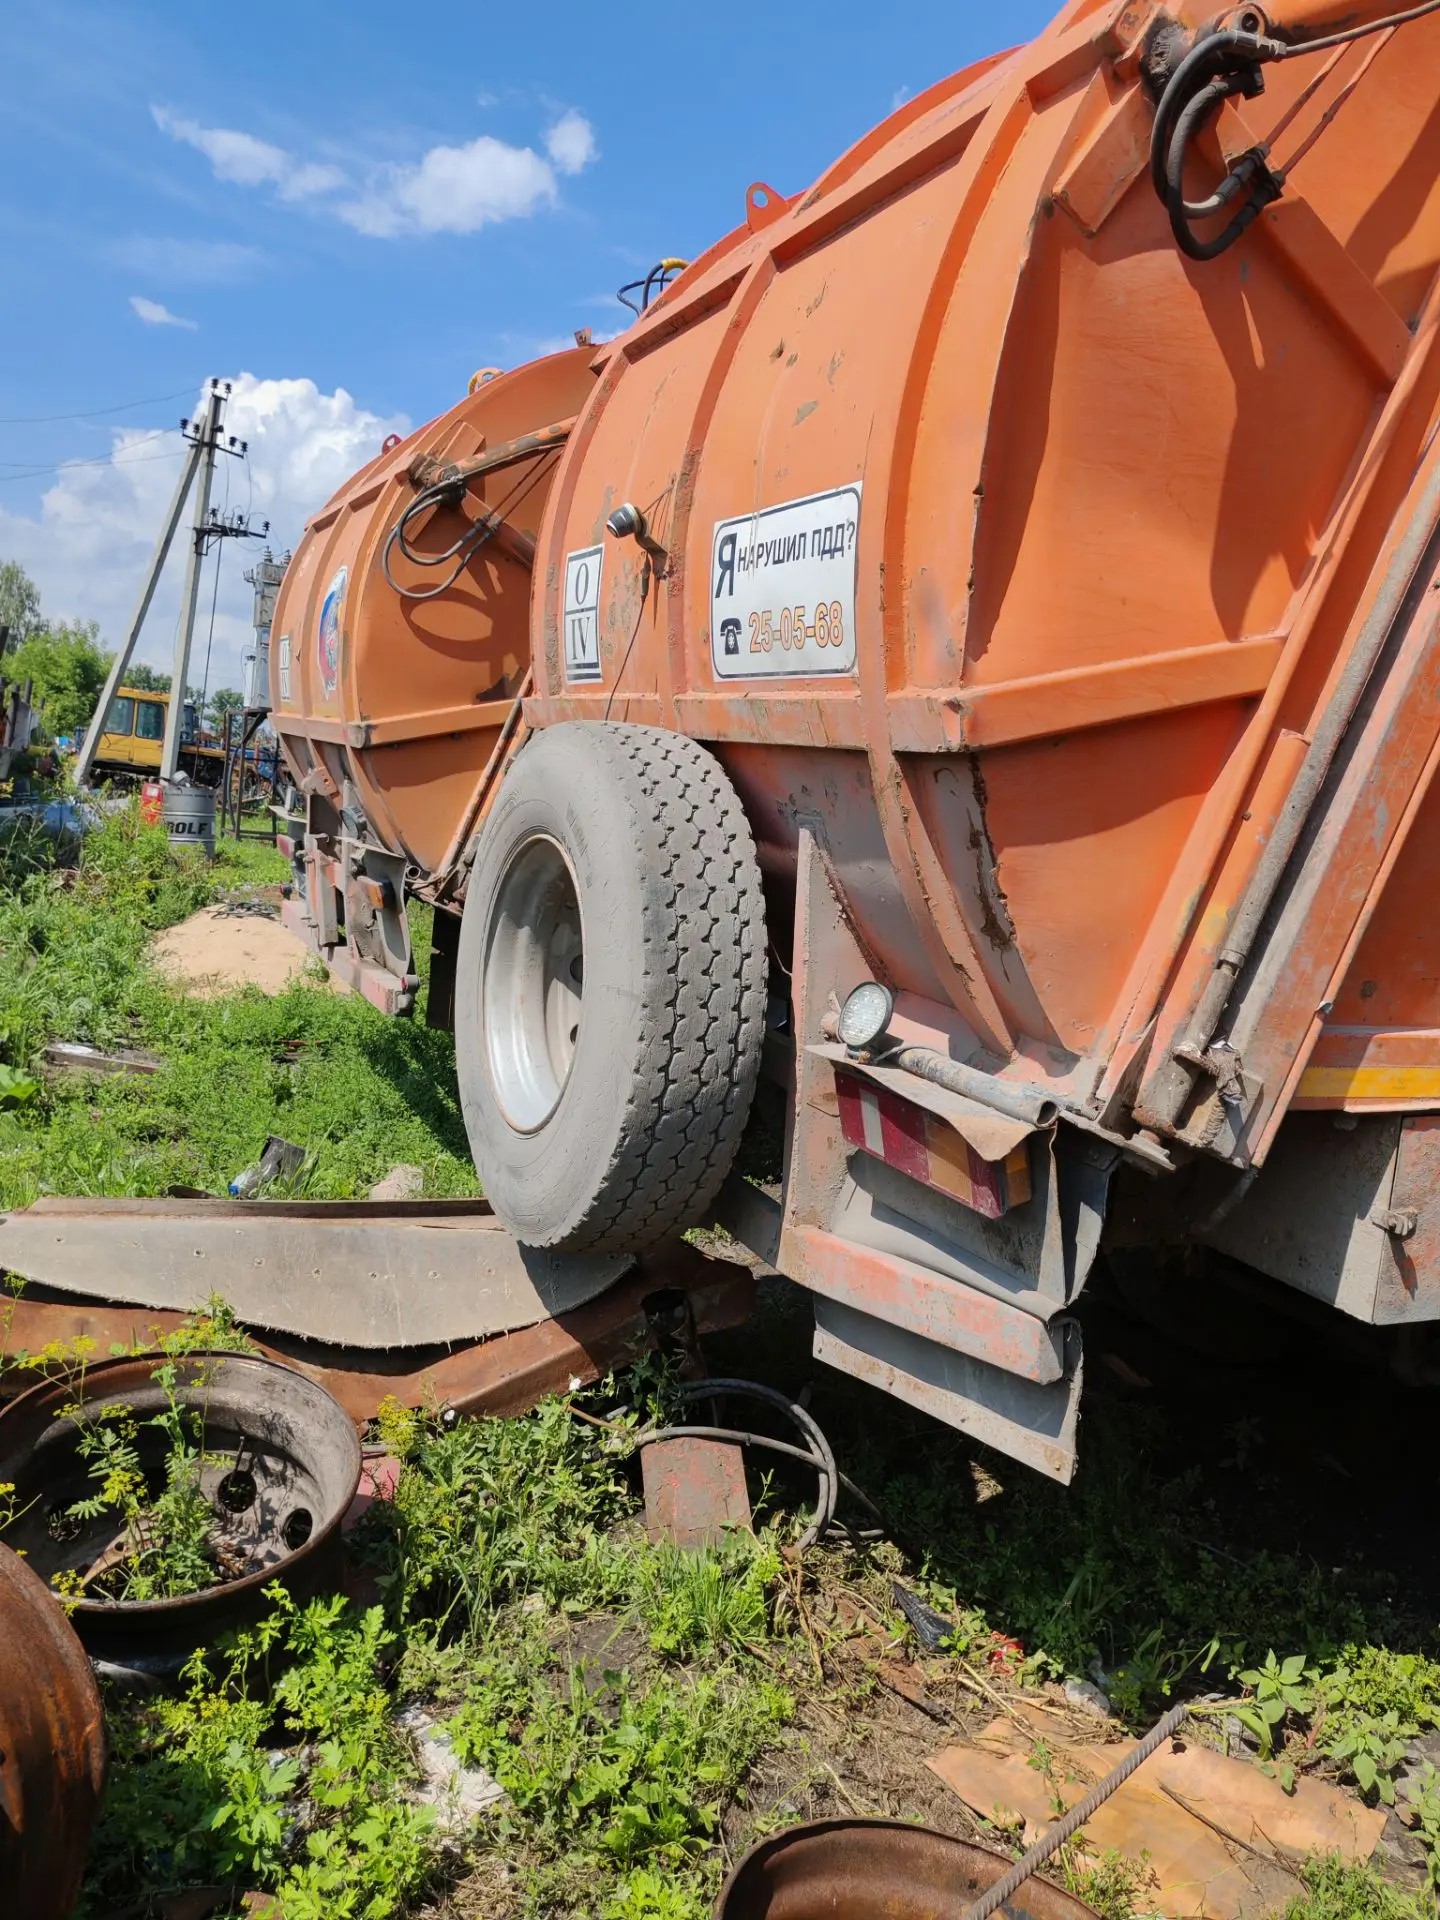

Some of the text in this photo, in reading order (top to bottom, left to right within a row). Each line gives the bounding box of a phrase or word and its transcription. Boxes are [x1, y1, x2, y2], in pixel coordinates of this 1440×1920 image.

[714, 520, 856, 599] Я НАРУШИЛ ПДД?
[571, 616, 591, 661] IV
[748, 600, 844, 654] 25-05-68
